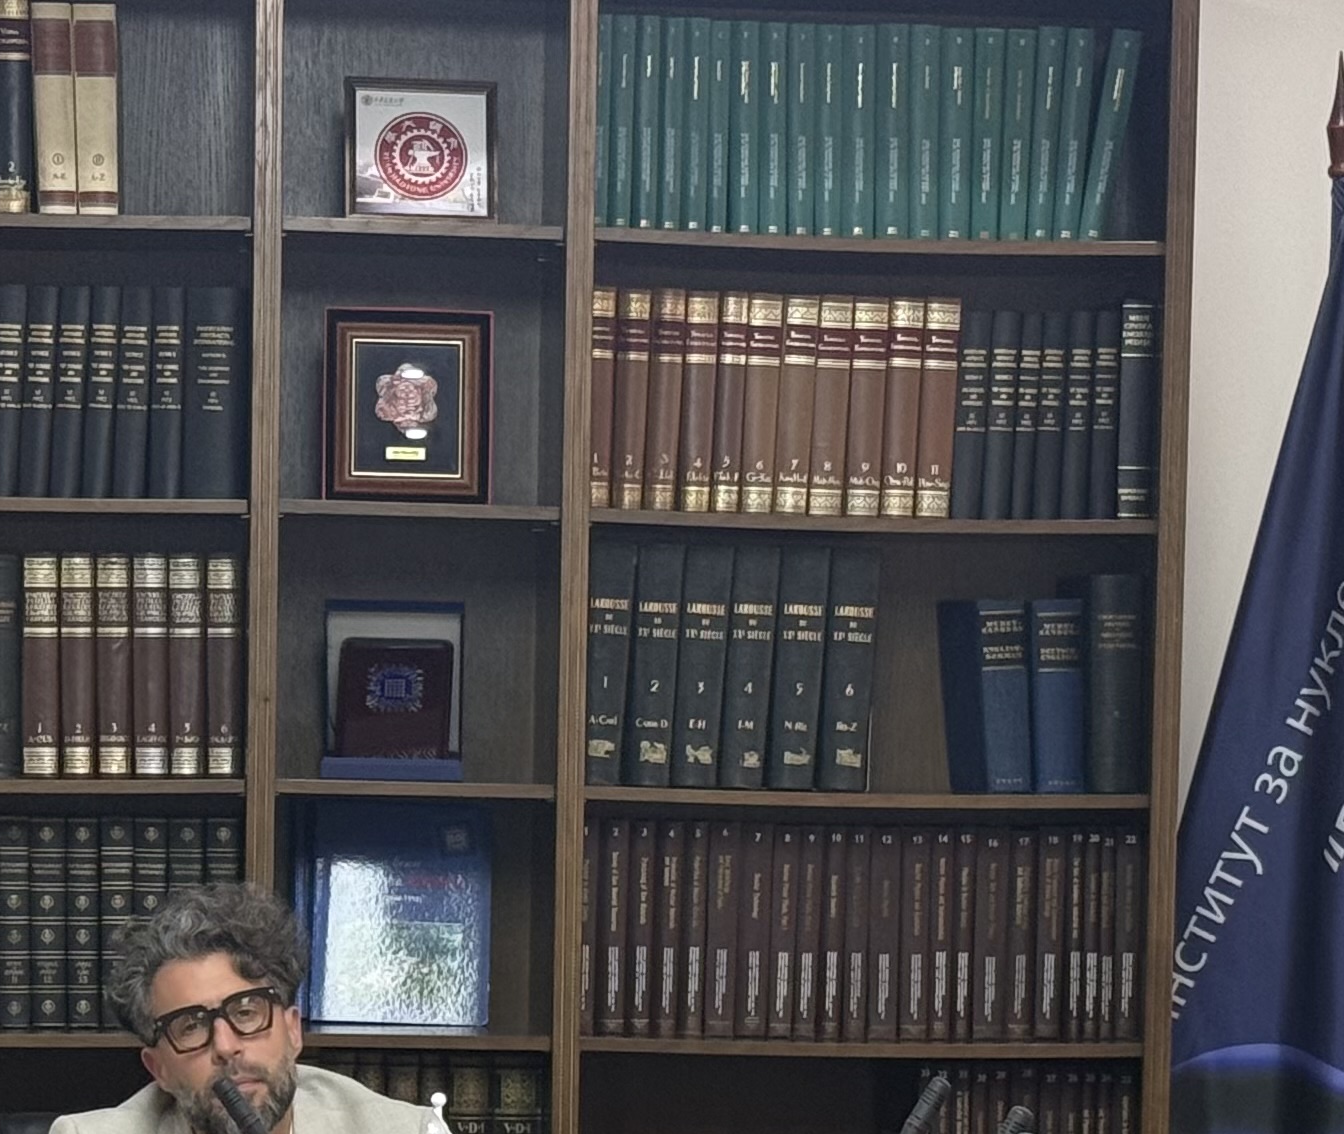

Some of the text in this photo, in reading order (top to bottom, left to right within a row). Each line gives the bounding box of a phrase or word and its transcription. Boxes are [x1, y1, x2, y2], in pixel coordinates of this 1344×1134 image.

[591, 598, 629, 610] LAROUSSE
[639, 601, 677, 613] LAROUSSE
[686, 602, 725, 616] LAROUSSE
[734, 602, 773, 616] LAROUSSE
[784, 603, 823, 616] LAROUSSE
[835, 605, 874, 618] LAROUSSE
[650, 679, 659, 692] 2
[697, 681, 705, 694] 3
[743, 681, 753, 694] 4
[795, 682, 804, 696] 5
[845, 683, 855, 697] 6
[1254, 745, 1304, 804] за
